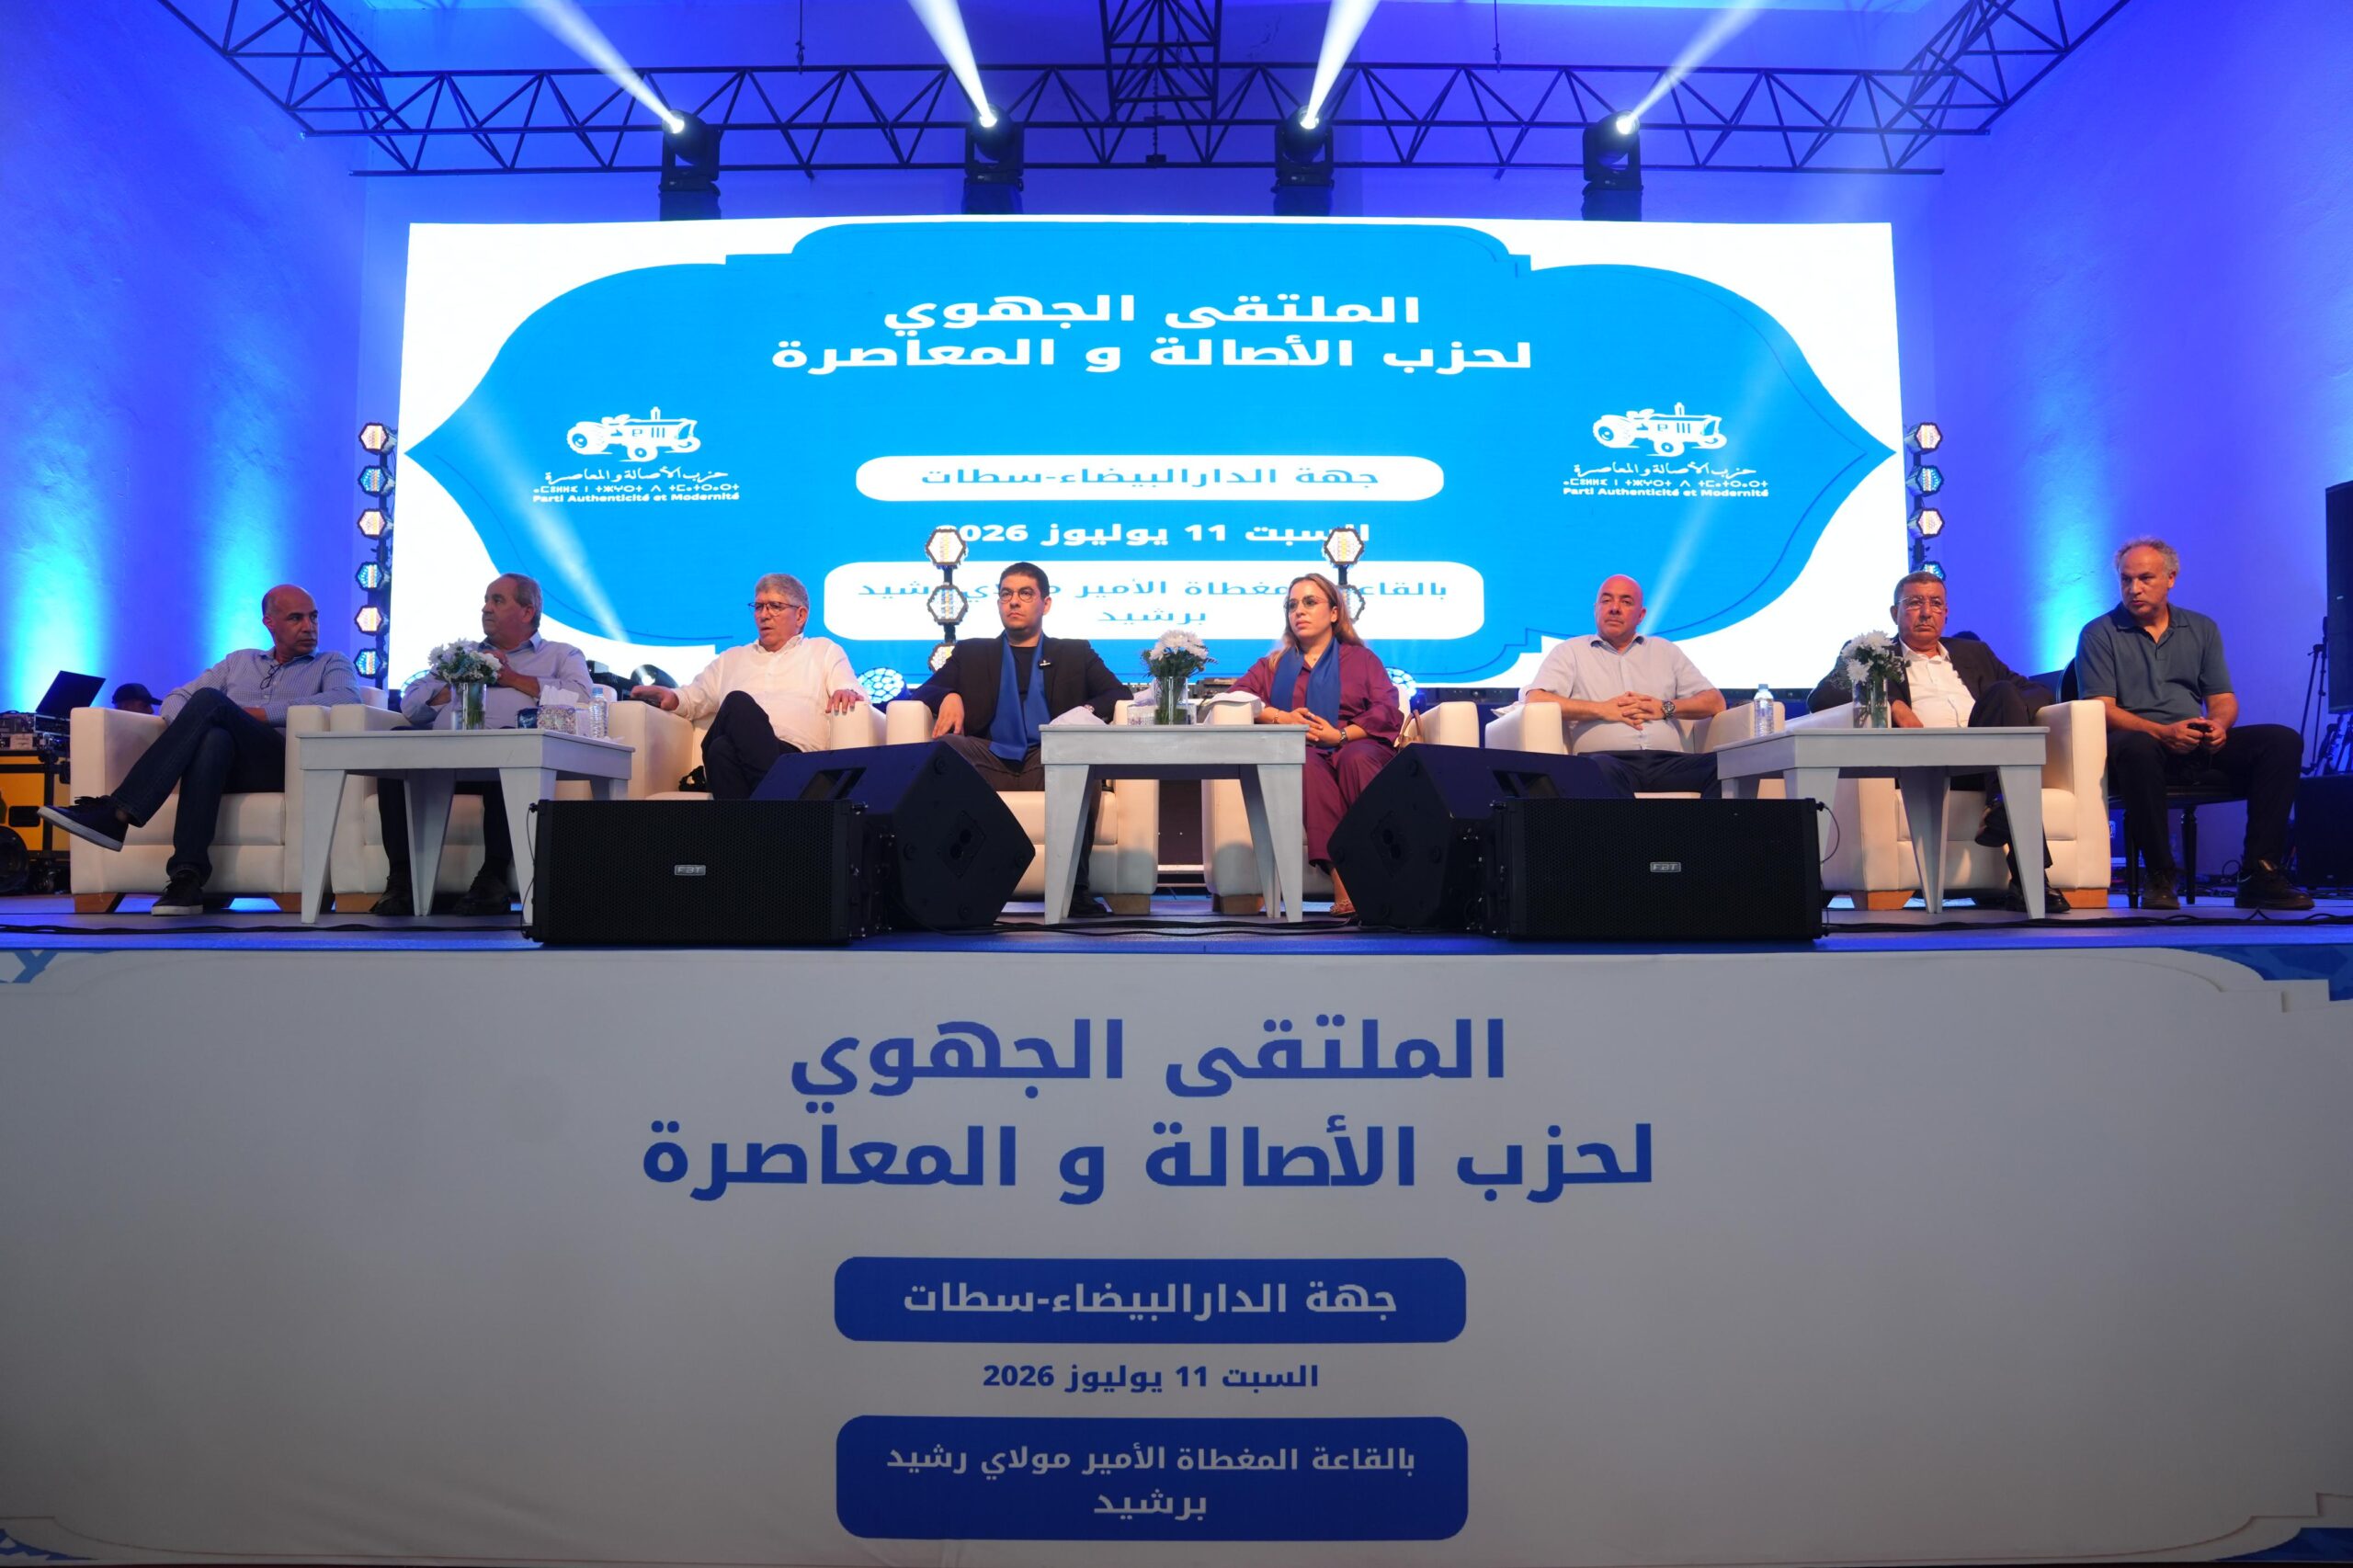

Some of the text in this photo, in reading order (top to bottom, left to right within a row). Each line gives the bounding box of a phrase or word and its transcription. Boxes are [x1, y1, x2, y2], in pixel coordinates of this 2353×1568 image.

[884, 294, 1419, 336] الملتقى الجهوي
[772, 334, 1530, 375] لحزب الأصالة و المعاصرة
[1296, 467, 1380, 488] جهة
[567, 494, 650, 502] Authenticité
[671, 492, 740, 501] Modernité
[1563, 487, 1594, 495] Parti
[1597, 487, 1679, 496] Authenticité
[936, 523, 1370, 547] اسبت 11 يوليوز 026
[858, 580, 929, 599] شيد
[1075, 578, 1166, 599] الأمير
[1185, 581, 1288, 596] مغطاة
[1360, 581, 1447, 600] بالقاع
[1098, 607, 1207, 626] برشيد
[791, 1014, 1505, 1114] الملتقى الجهوي
[643, 1114, 1653, 1205] لحزب الأصالة و المعاصرة
[1307, 1281, 1395, 1321] جهة
[984, 1364, 1319, 1393] السبت 11 يوليوز 2026
[887, 1442, 1415, 1481] بالقاعة المغطاة الأمير مولاي رشيد
[1094, 1488, 1207, 1521] برشيد
